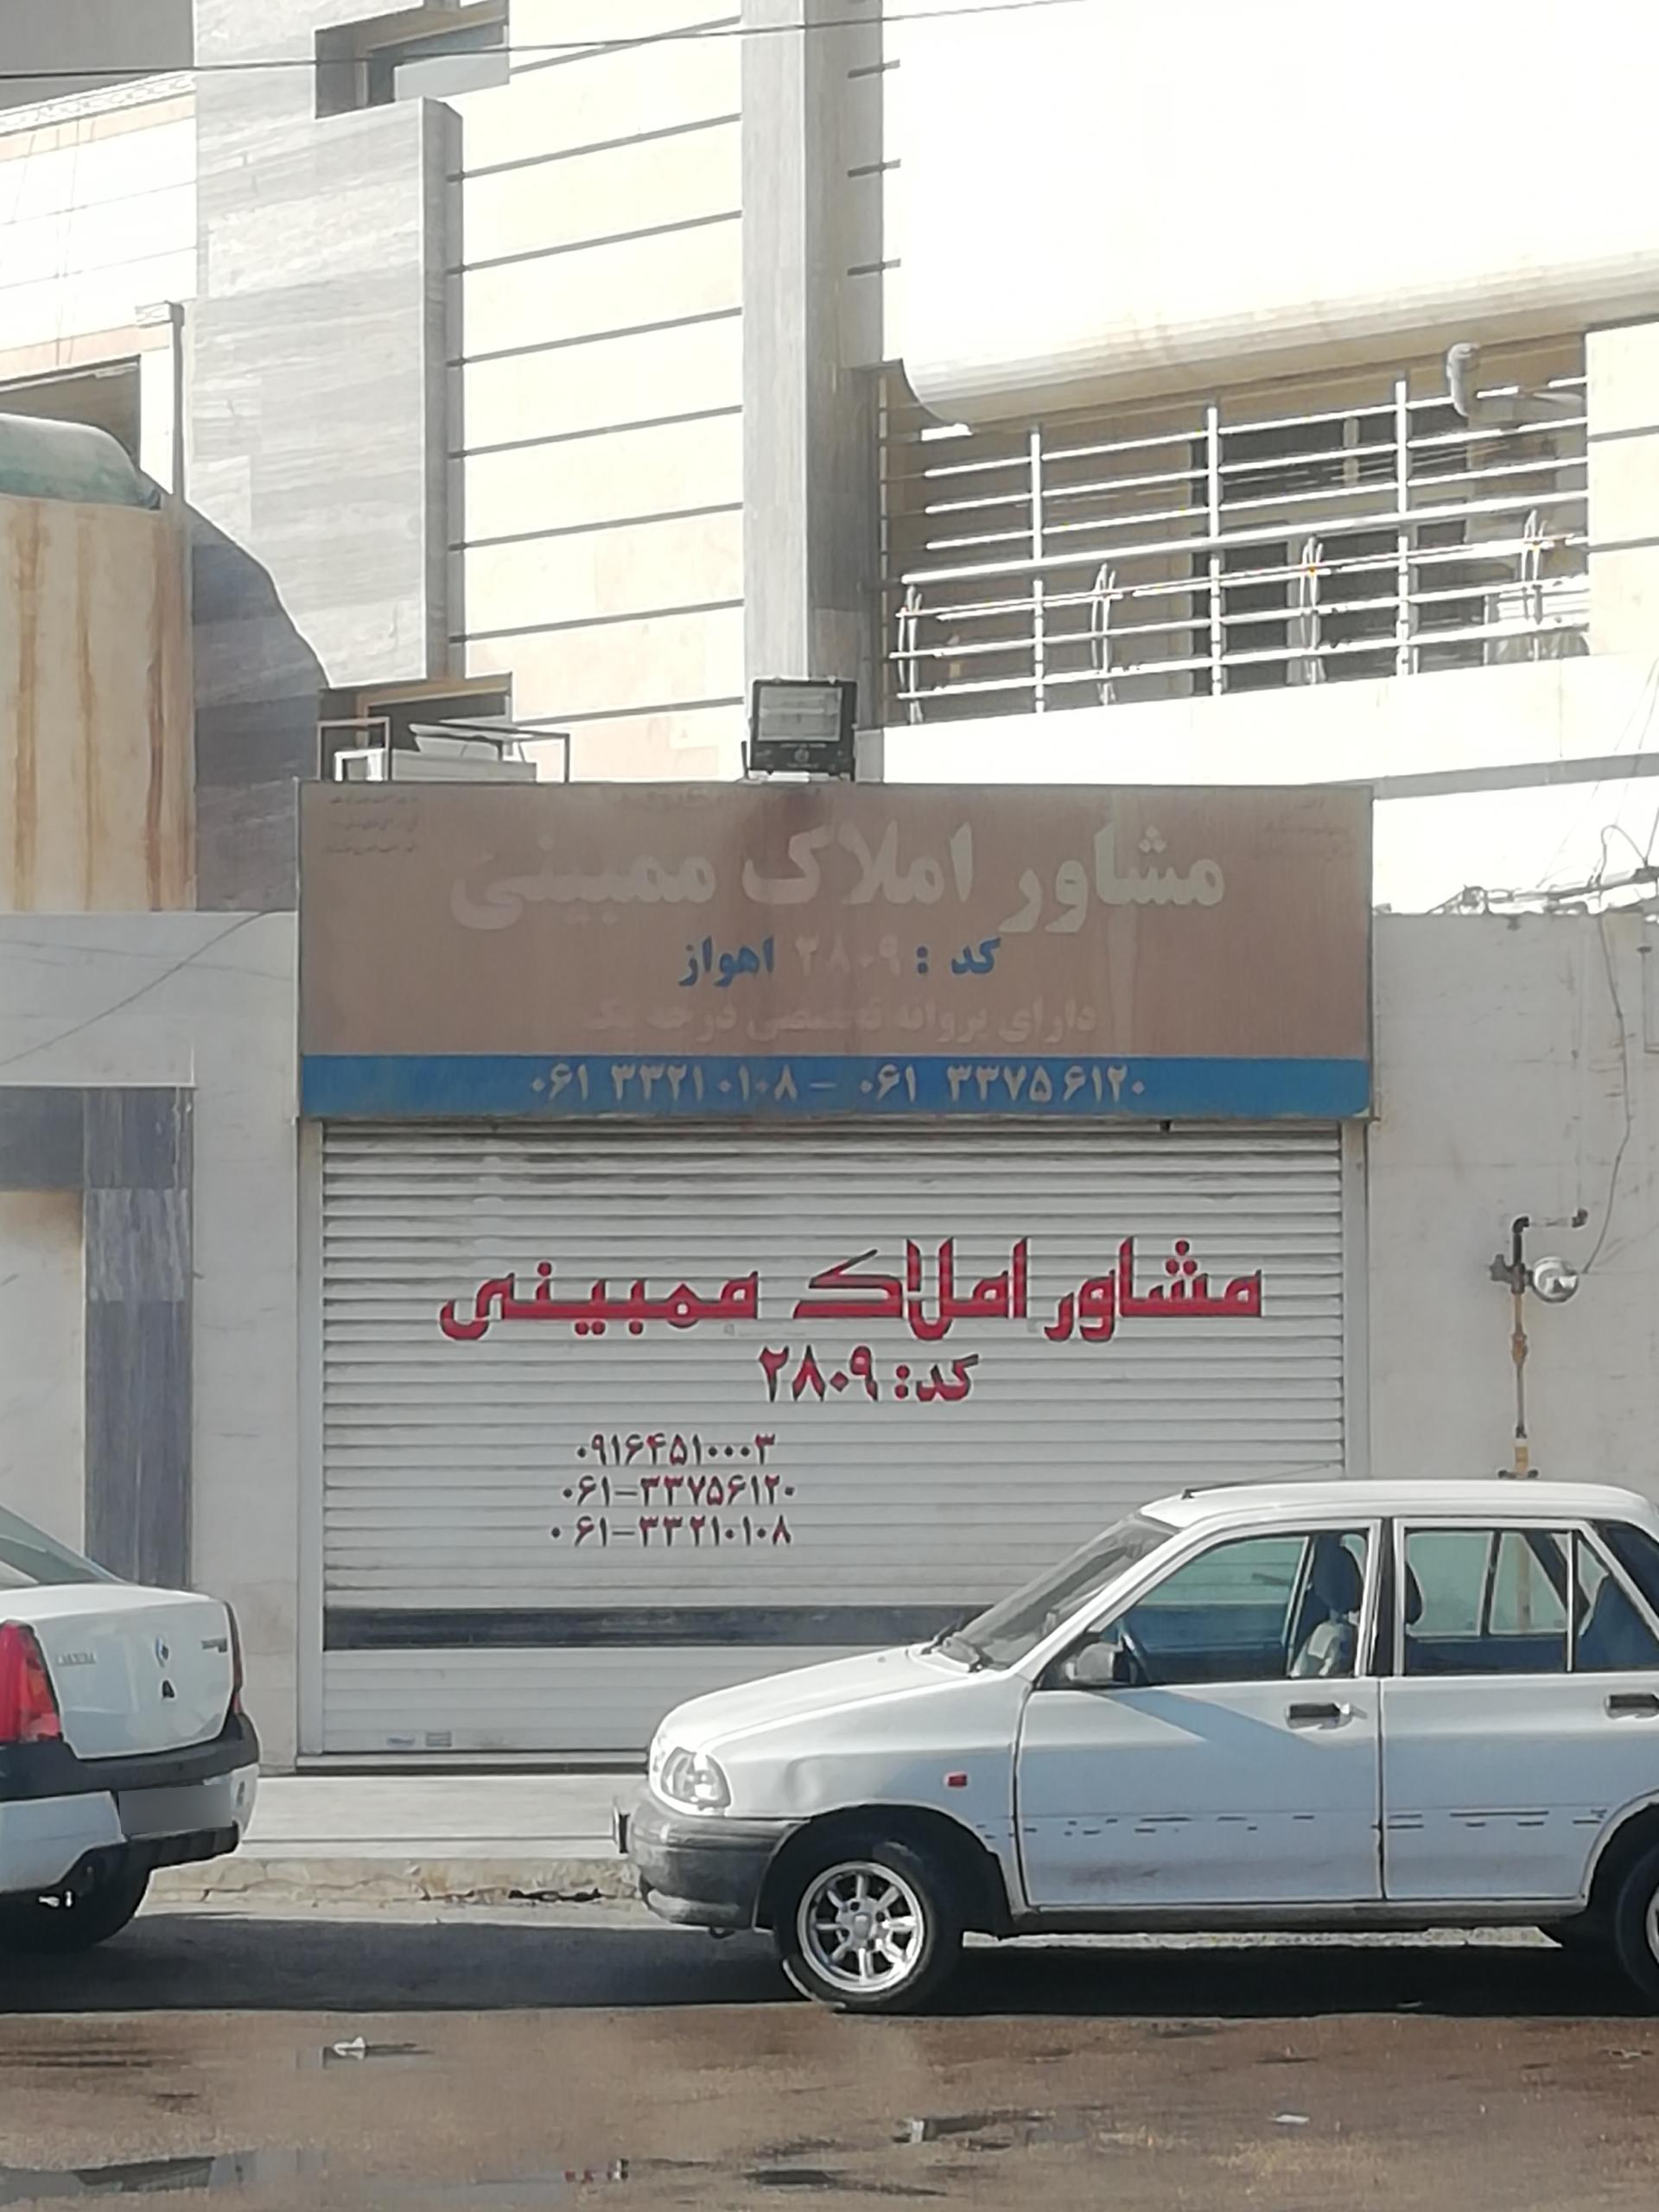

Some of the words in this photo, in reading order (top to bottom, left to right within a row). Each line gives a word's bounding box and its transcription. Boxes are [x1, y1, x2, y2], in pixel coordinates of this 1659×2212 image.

[742, 818, 974, 906] املاک
[999, 823, 1226, 933] مشاور
[678, 935, 775, 987] اهواز
[796, 934, 902, 978] ۲۸۰۹
[531, 1063, 589, 1103] ۰۶۱
[861, 1064, 918, 1103] ۰۶۱
[439, 1261, 759, 1342] ممبینی
[792, 1236, 1031, 1342] املاک
[1043, 1237, 1262, 1342] مشاور
[758, 1344, 879, 1402] ۲۸۰۹
[576, 1433, 776, 1466] ۰۹۱۶۴۵۱۰۰۰۳
